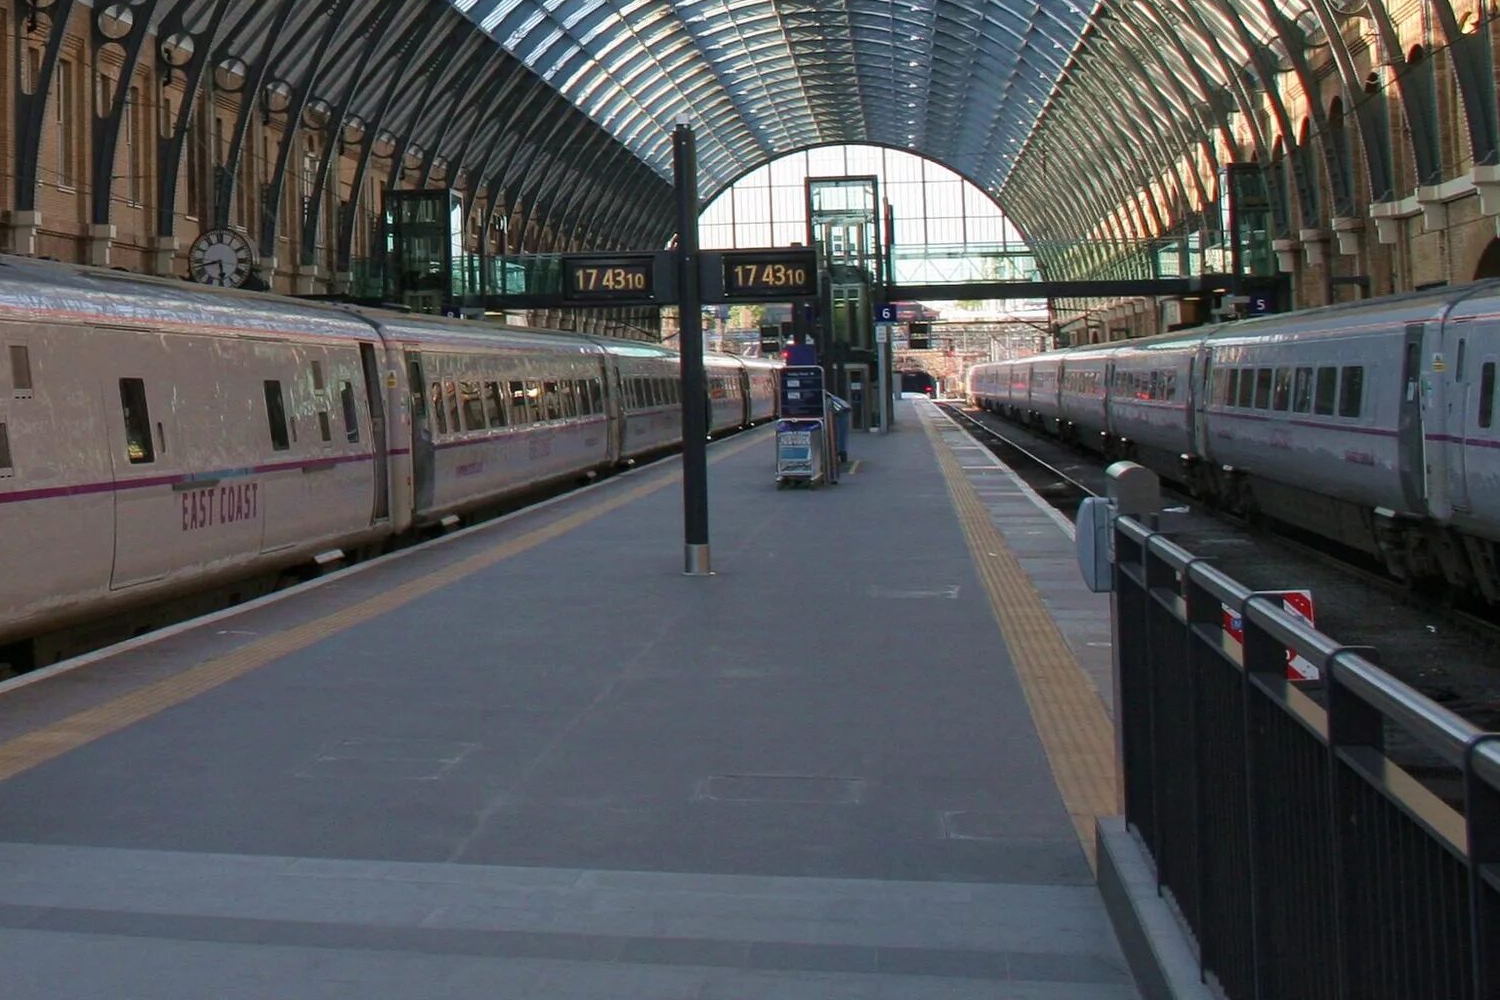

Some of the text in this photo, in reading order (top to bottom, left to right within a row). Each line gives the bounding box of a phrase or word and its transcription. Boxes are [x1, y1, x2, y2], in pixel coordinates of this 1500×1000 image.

[575, 268, 598, 291] 17
[733, 264, 756, 287] 17
[882, 308, 891, 319] 6
[1257, 299, 1265, 310] 5
[182, 483, 258, 531] EAST COAST
